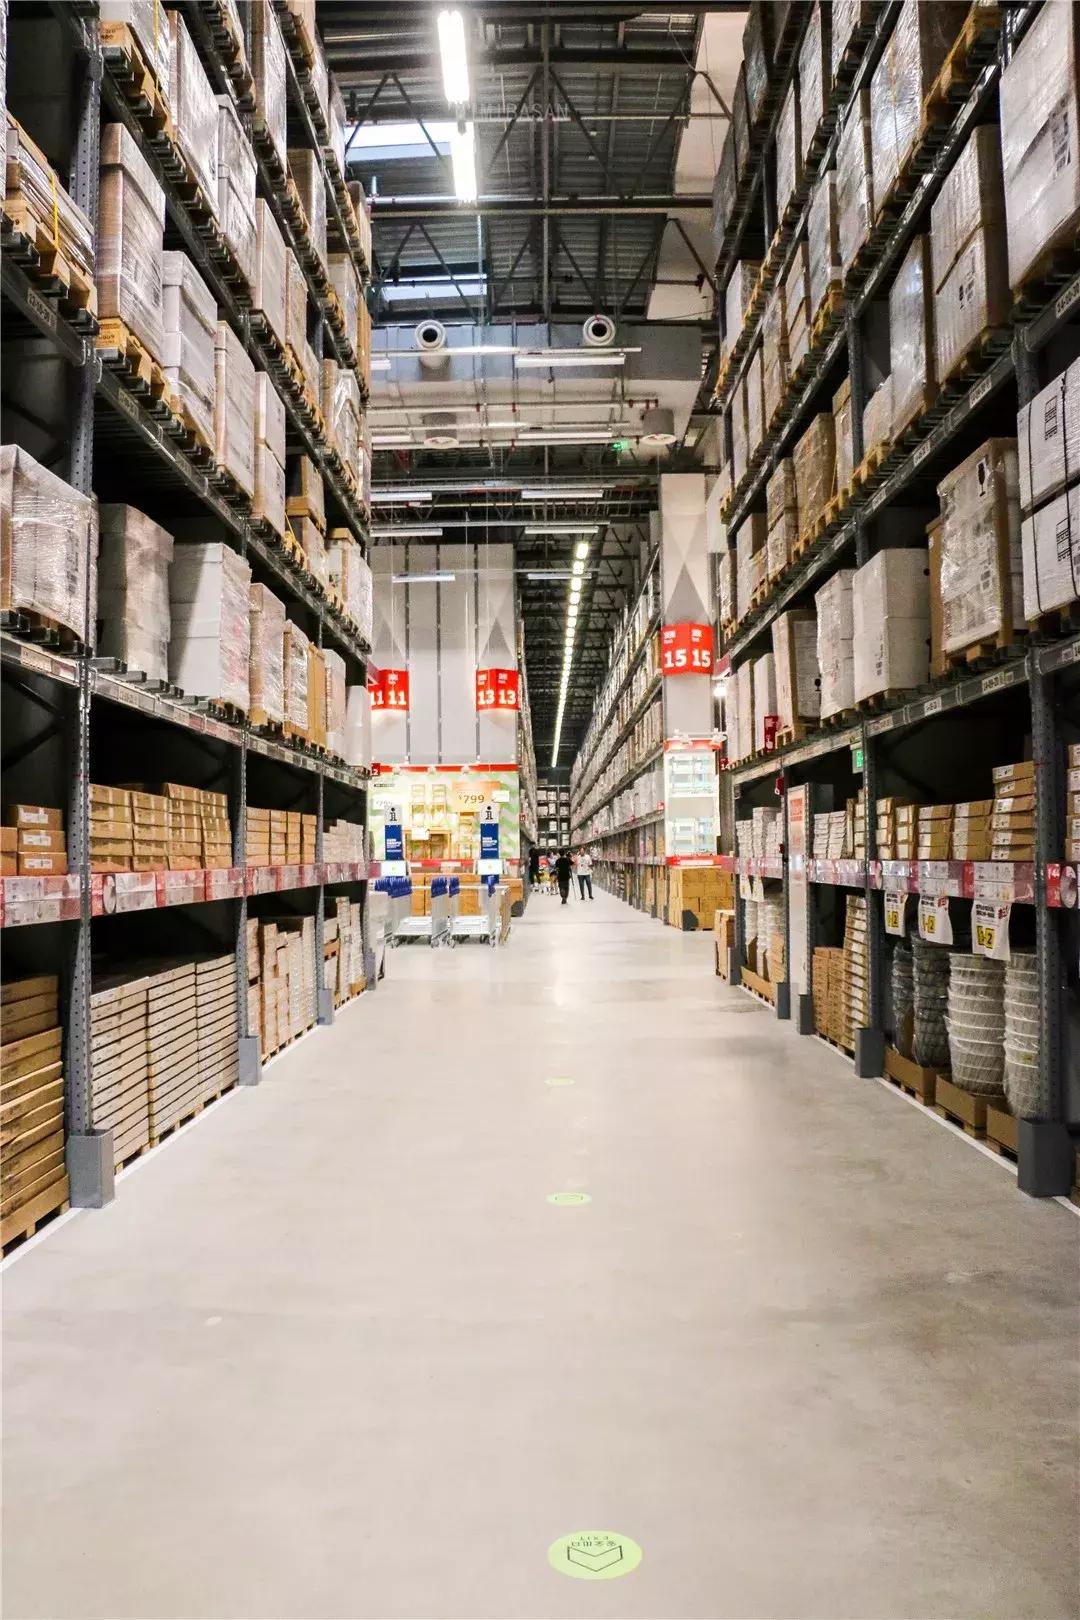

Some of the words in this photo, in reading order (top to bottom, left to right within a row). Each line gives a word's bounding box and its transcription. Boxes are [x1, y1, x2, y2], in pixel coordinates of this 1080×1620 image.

[664, 649, 687, 668] 15
[692, 648, 711, 668] 15
[370, 690, 384, 706] 11
[388, 690, 407, 706] 11
[478, 689, 495, 705] 13
[498, 689, 516, 705] 13
